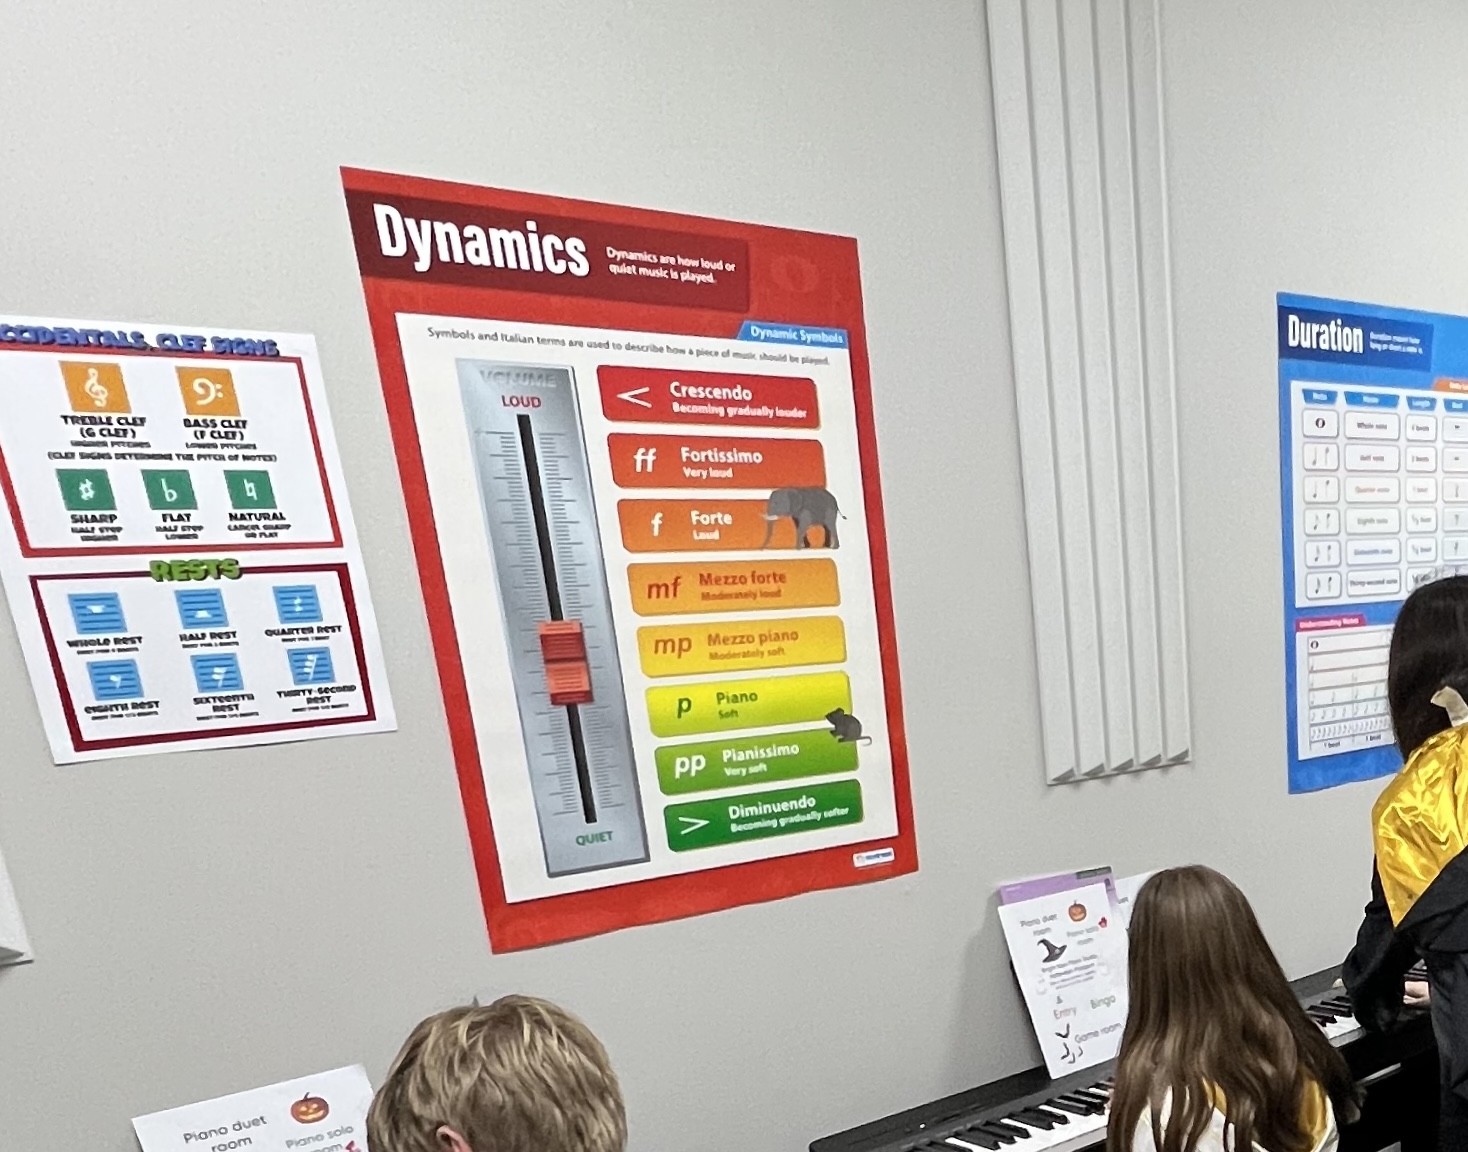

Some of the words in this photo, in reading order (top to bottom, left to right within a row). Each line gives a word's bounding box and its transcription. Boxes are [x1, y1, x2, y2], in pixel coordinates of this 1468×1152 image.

[373, 203, 590, 277] Dynamics
[606, 246, 658, 261] Dynamics
[660, 255, 676, 265] are
[677, 255, 700, 267] how
[700, 258, 723, 270] loud
[725, 263, 736, 271] or
[609, 263, 637, 275] quiet
[639, 266, 669, 278] music
[670, 268, 679, 279] is
[680, 270, 716, 284] played.
[0, 324, 153, 351] CCIDENTALS,
[427, 327, 476, 340] Symbols
[478, 332, 499, 342] and
[501, 333, 535, 344] Italian
[537, 336, 566, 347] terms
[568, 339, 584, 348] are
[586, 340, 610, 350] used
[612, 341, 622, 350] to
[625, 342, 664, 353] describe
[666, 345, 686, 355] how
[696, 347, 719, 358] piece
[750, 325, 799, 340] Dynamic
[800, 329, 844, 344] Symbols
[1288, 315, 1363, 354] Duration
[670, 381, 753, 401] Crescendo
[501, 395, 542, 409] LOUD
[672, 402, 725, 417] Becoming
[727, 405, 774, 420] gradually
[775, 407, 807, 419] louder
[60, 415, 113, 426] TREBLE
[116, 417, 146, 427] CLEF
[183, 418, 217, 429] BASS
[220, 420, 247, 429] CLEF
[633, 447, 657, 473] ff
[680, 446, 763, 464] Fortissimo
[682, 467, 707, 480] Very
[709, 467, 734, 478] loud
[71, 514, 118, 524] SHARP
[161, 513, 191, 522] FLAT
[228, 512, 286, 521] NATURAL
[651, 512, 663, 536] f
[691, 510, 733, 525] Forte
[693, 529, 720, 540] Loud
[149, 558, 243, 582] RESTS
[699, 572, 748, 586] Mezzo
[751, 570, 787, 585] forte
[647, 576, 682, 600] mf
[701, 589, 758, 601] Moderately
[707, 633, 755, 647] Mezzo
[759, 629, 799, 647] piano
[654, 636, 692, 660] mp
[709, 647, 765, 661] Moderately
[767, 646, 785, 656] soft
[677, 697, 692, 719] p
[716, 692, 758, 706] Piano
[718, 709, 739, 720] Soft
[722, 743, 800, 763] Pianissimo
[675, 754, 706, 779] pp
[724, 766, 747, 778] Very
[748, 762, 768, 775] soft
[728, 795, 817, 821] Diminuendo
[730, 820, 778, 833] Becoming
[779, 810, 822, 827] gradually
[823, 806, 850, 818] softer
[575, 831, 613, 846] QUIET
[1090, 995, 1116, 1010] Bingo
[1074, 1030, 1100, 1044] Game
[183, 1126, 228, 1144] Piano
[232, 1115, 268, 1132] duet
[285, 1132, 325, 1150] Piano
[327, 1125, 355, 1140] solo
